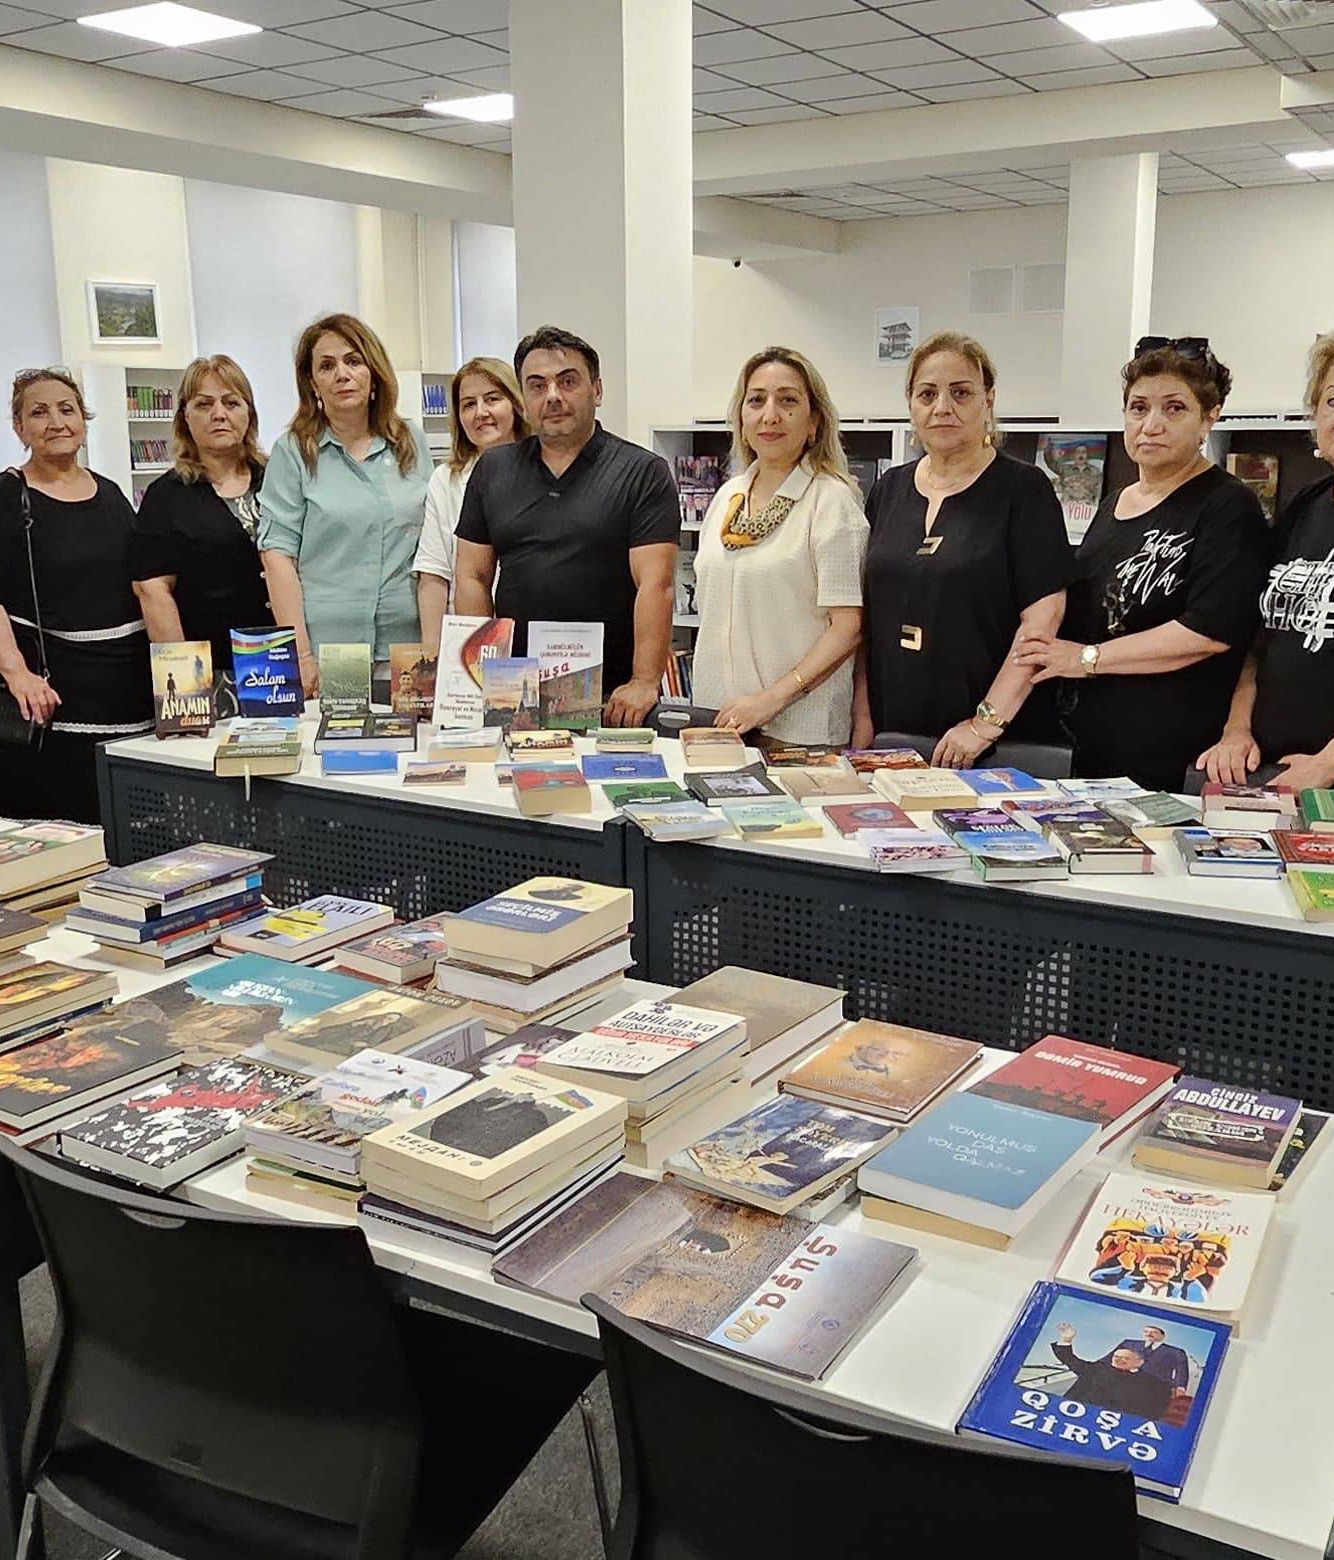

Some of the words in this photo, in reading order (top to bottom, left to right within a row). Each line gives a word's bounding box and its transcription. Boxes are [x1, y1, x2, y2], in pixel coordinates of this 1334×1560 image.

[245, 665, 286, 686] Salam
[161, 697, 210, 720] ANAMIN
[266, 686, 296, 705] olsun
[1173, 1089, 1286, 1122] ABDULLAYEV
[754, 1235, 838, 1310] Şuşa
[1022, 1390, 1163, 1441] QOŞA
[1010, 1410, 1158, 1462] ZİRVƏ
